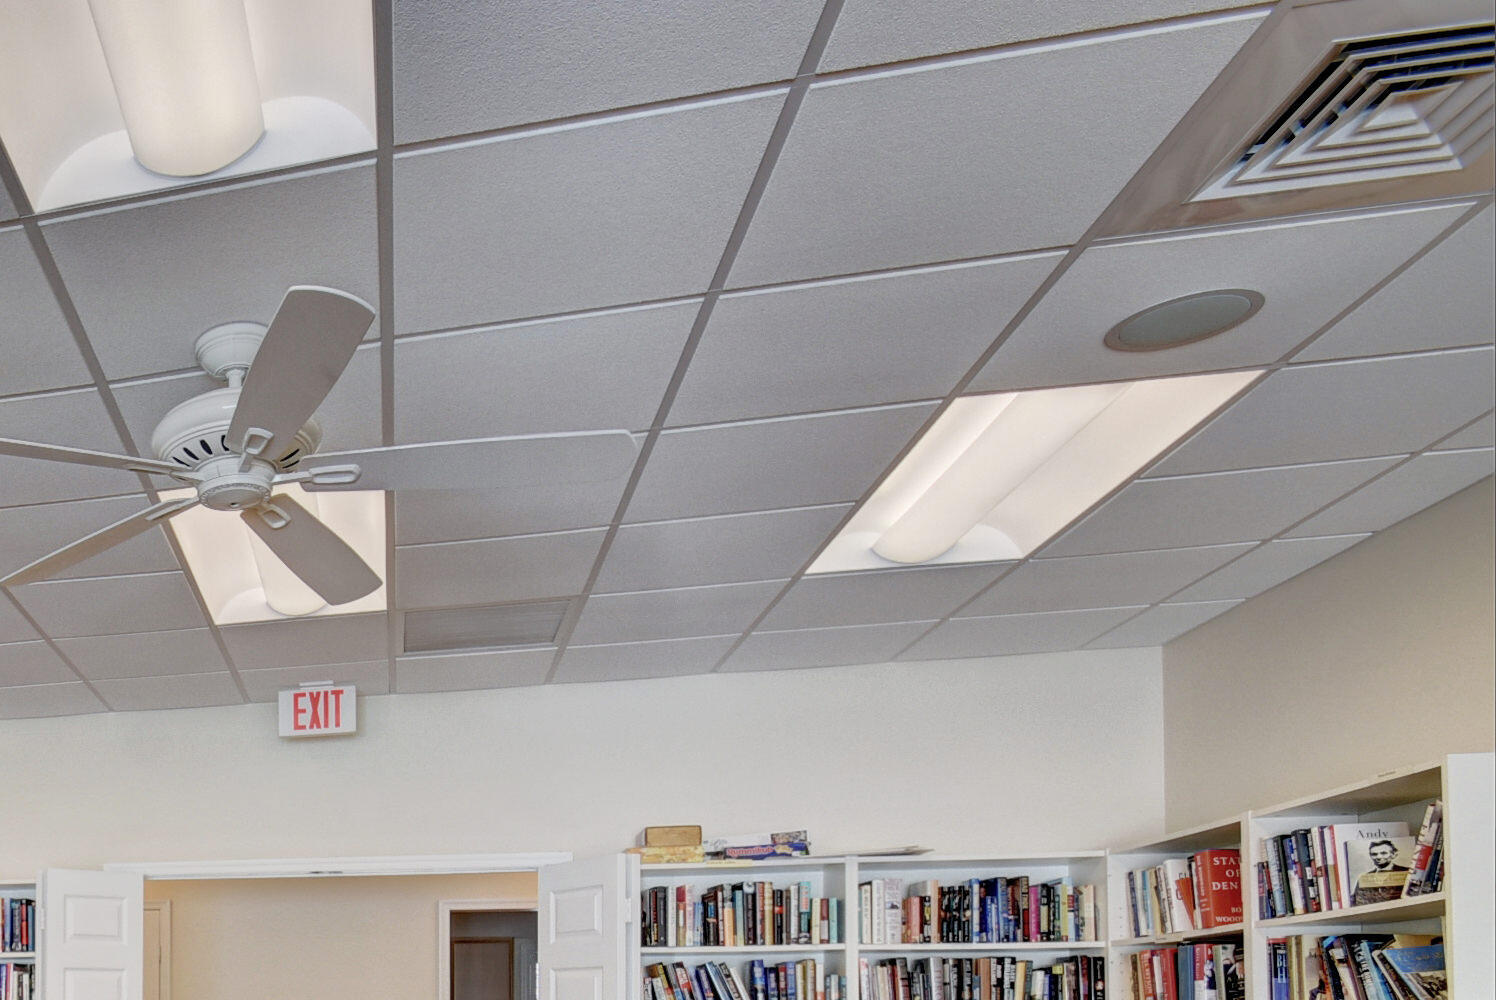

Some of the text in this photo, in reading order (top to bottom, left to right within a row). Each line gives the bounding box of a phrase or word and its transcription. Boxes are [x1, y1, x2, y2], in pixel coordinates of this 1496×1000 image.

[294, 690, 344, 730] EXIT
[1358, 829, 1388, 838] Andy
[1213, 857, 1240, 865] STAT
[1212, 881, 1238, 890] DEN
